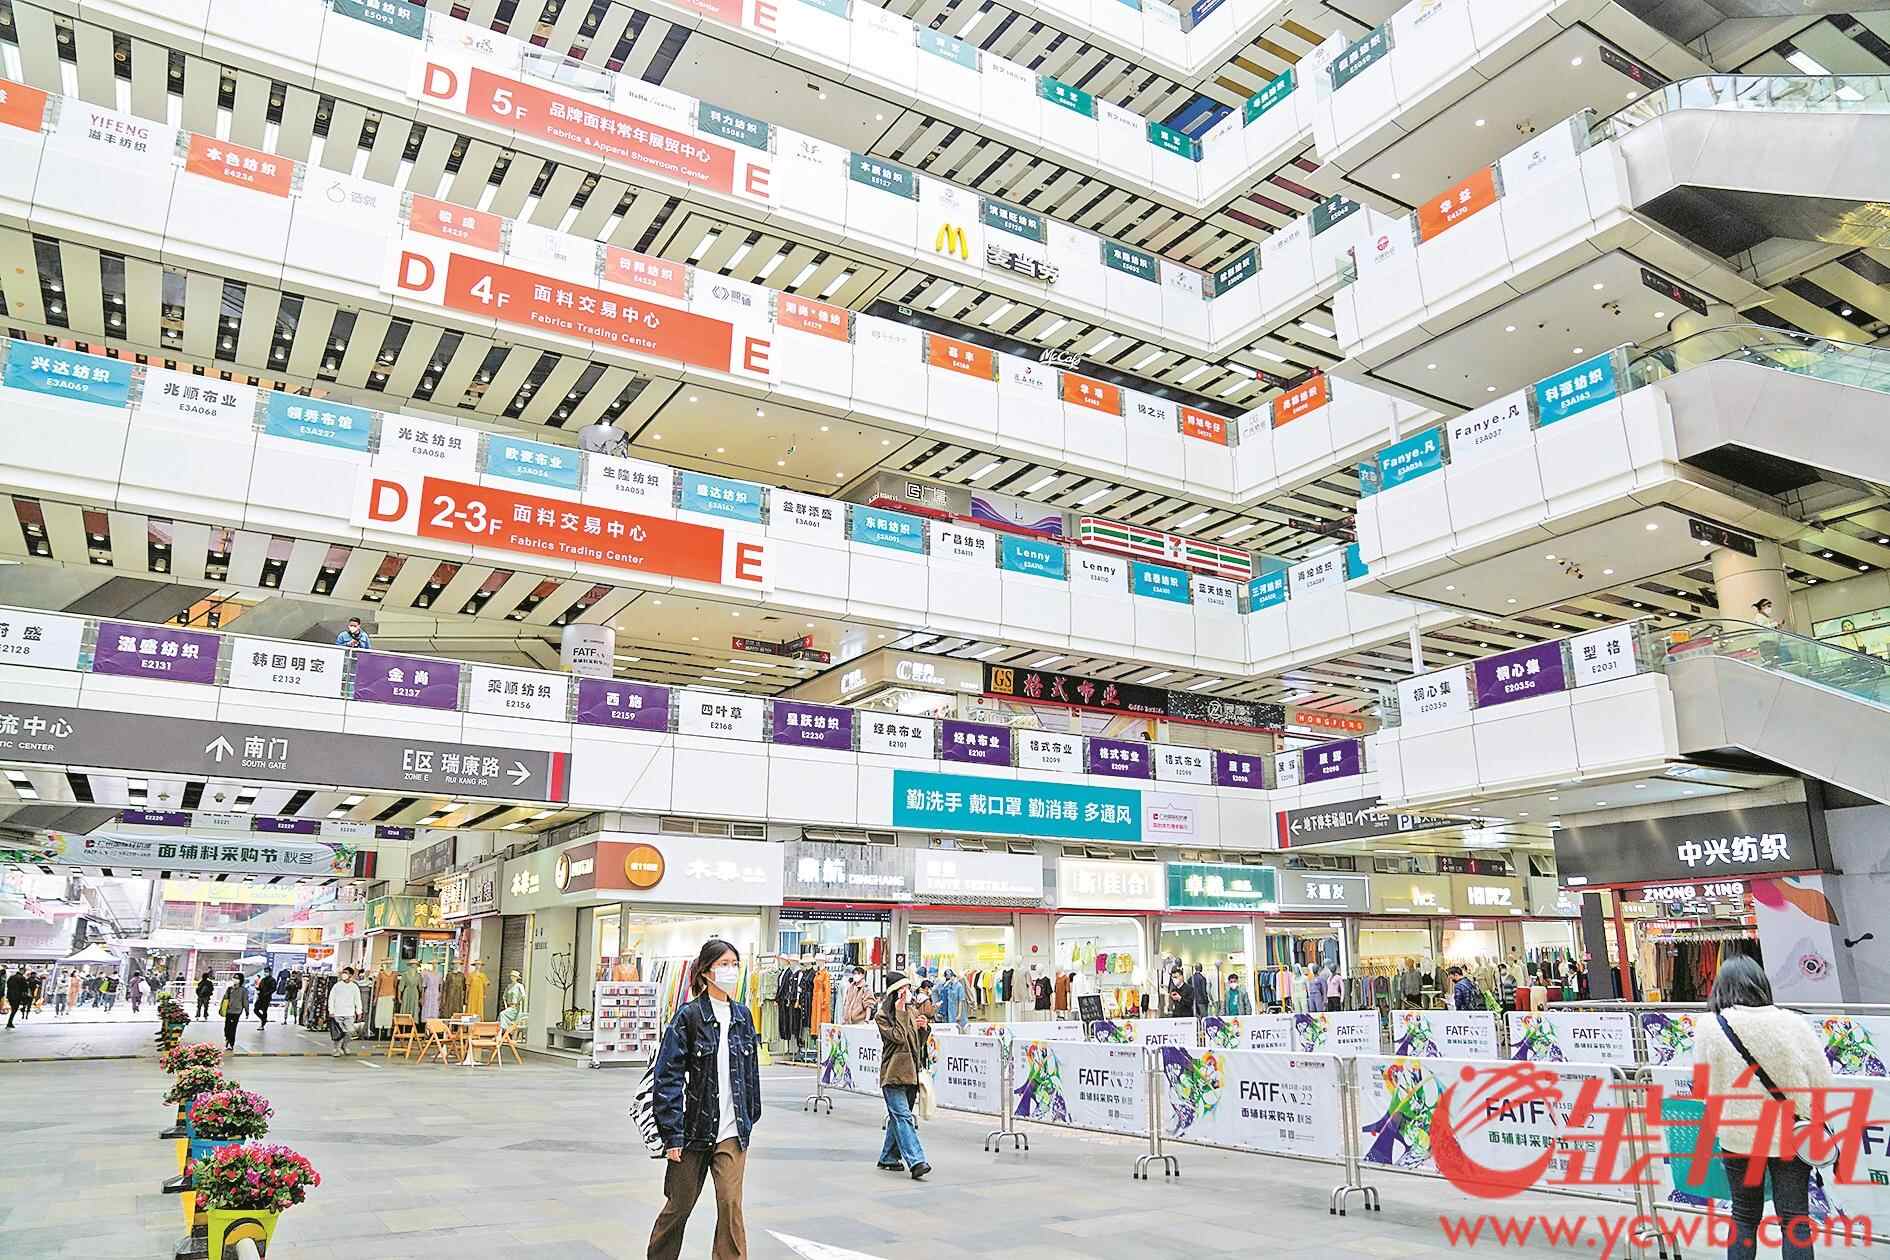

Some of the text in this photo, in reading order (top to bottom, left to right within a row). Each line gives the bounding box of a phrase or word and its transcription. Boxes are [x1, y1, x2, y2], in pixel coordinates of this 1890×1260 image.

[422, 61, 458, 100] D
[490, 87, 528, 120] 5F
[90, 113, 150, 140] YIFENG
[548, 102, 711, 163] 品牌面料常年展贸中心
[87, 127, 147, 153] 溢丰纺织
[206, 146, 278, 177] 本色纺织
[546, 126, 581, 146] Fabrics
[591, 138, 630, 159] Apparel
[630, 149, 679, 174] Showroom
[680, 163, 711, 182] Center
[746, 162, 770, 198] E
[397, 250, 435, 292] D
[469, 275, 511, 308] 4F
[533, 285, 661, 329] 面料交易中心
[530, 312, 657, 349] Fabrics Trading Center
[744, 336, 770, 373] E
[31, 355, 111, 383] 兴达纺织
[163, 381, 238, 408] 兆顺布业
[178, 402, 218, 417] E3A068
[398, 426, 464, 450] 光达纺织
[602, 466, 660, 488] 生隆纺织
[368, 477, 409, 522] D
[430, 493, 503, 536] 2-3F
[513, 503, 648, 542] 面料交易中心
[509, 533, 644, 564] Fabrics Trading Center
[1016, 547, 1051, 563] Lenny
[735, 542, 763, 582] E
[1083, 560, 1116, 576] Lenny
[141, 659, 172, 672] E2131
[252, 651, 326, 674] 韩国明宝
[1591, 660, 1619, 675] E2031
[272, 674, 302, 685] E2132
[386, 667, 431, 686] 金尚
[392, 687, 421, 698] E2137
[606, 691, 643, 709] 西施
[505, 700, 532, 710] E2156
[701, 703, 743, 720] 四叶草
[610, 710, 636, 721] E2159
[710, 720, 733, 731] E2168
[786, 713, 840, 730] 星跃纺织
[0, 714, 74, 738] 流中心
[801, 729, 824, 741] E2230
[872, 722, 922, 739] 经典布业
[18, 741, 56, 752] CENTER
[243, 735, 290, 761] 南门
[888, 739, 908, 750] E2101
[953, 731, 1000, 748] 经典布业
[1029, 740, 1073, 755] 格式布业
[241, 759, 287, 770] SOUTH GATE
[402, 749, 500, 778] E区 瑞康路
[1099, 747, 1140, 763] 格式布业
[404, 772, 422, 781] ZONE
[445, 775, 458, 784] RUI
[458, 777, 477, 785] KANG
[905, 787, 963, 812] 勤洗手
[969, 794, 1023, 817] 戴口罩
[1028, 797, 1079, 821] 勤消毒
[1083, 801, 1132, 825] 多通风
[158, 843, 278, 863] 面辅料采购节
[1676, 833, 1792, 868] 中兴纺织
[1643, 881, 1744, 901] ZHONG XING
[1145, 1034, 1169, 1046] FATF
[1250, 1029, 1272, 1041] FATF
[1337, 1025, 1356, 1036] FATF
[1446, 1025, 1469, 1036] FATF
[1572, 1027, 1600, 1040] FATF
[858, 1046, 878, 1061] FATF
[946, 1057, 969, 1073] FATF
[1079, 1067, 1109, 1087] FATF
[1240, 1080, 1280, 1102] FATF
[1241, 1107, 1295, 1123] 面辅料采购节
[1486, 1097, 1544, 1125] FATF
